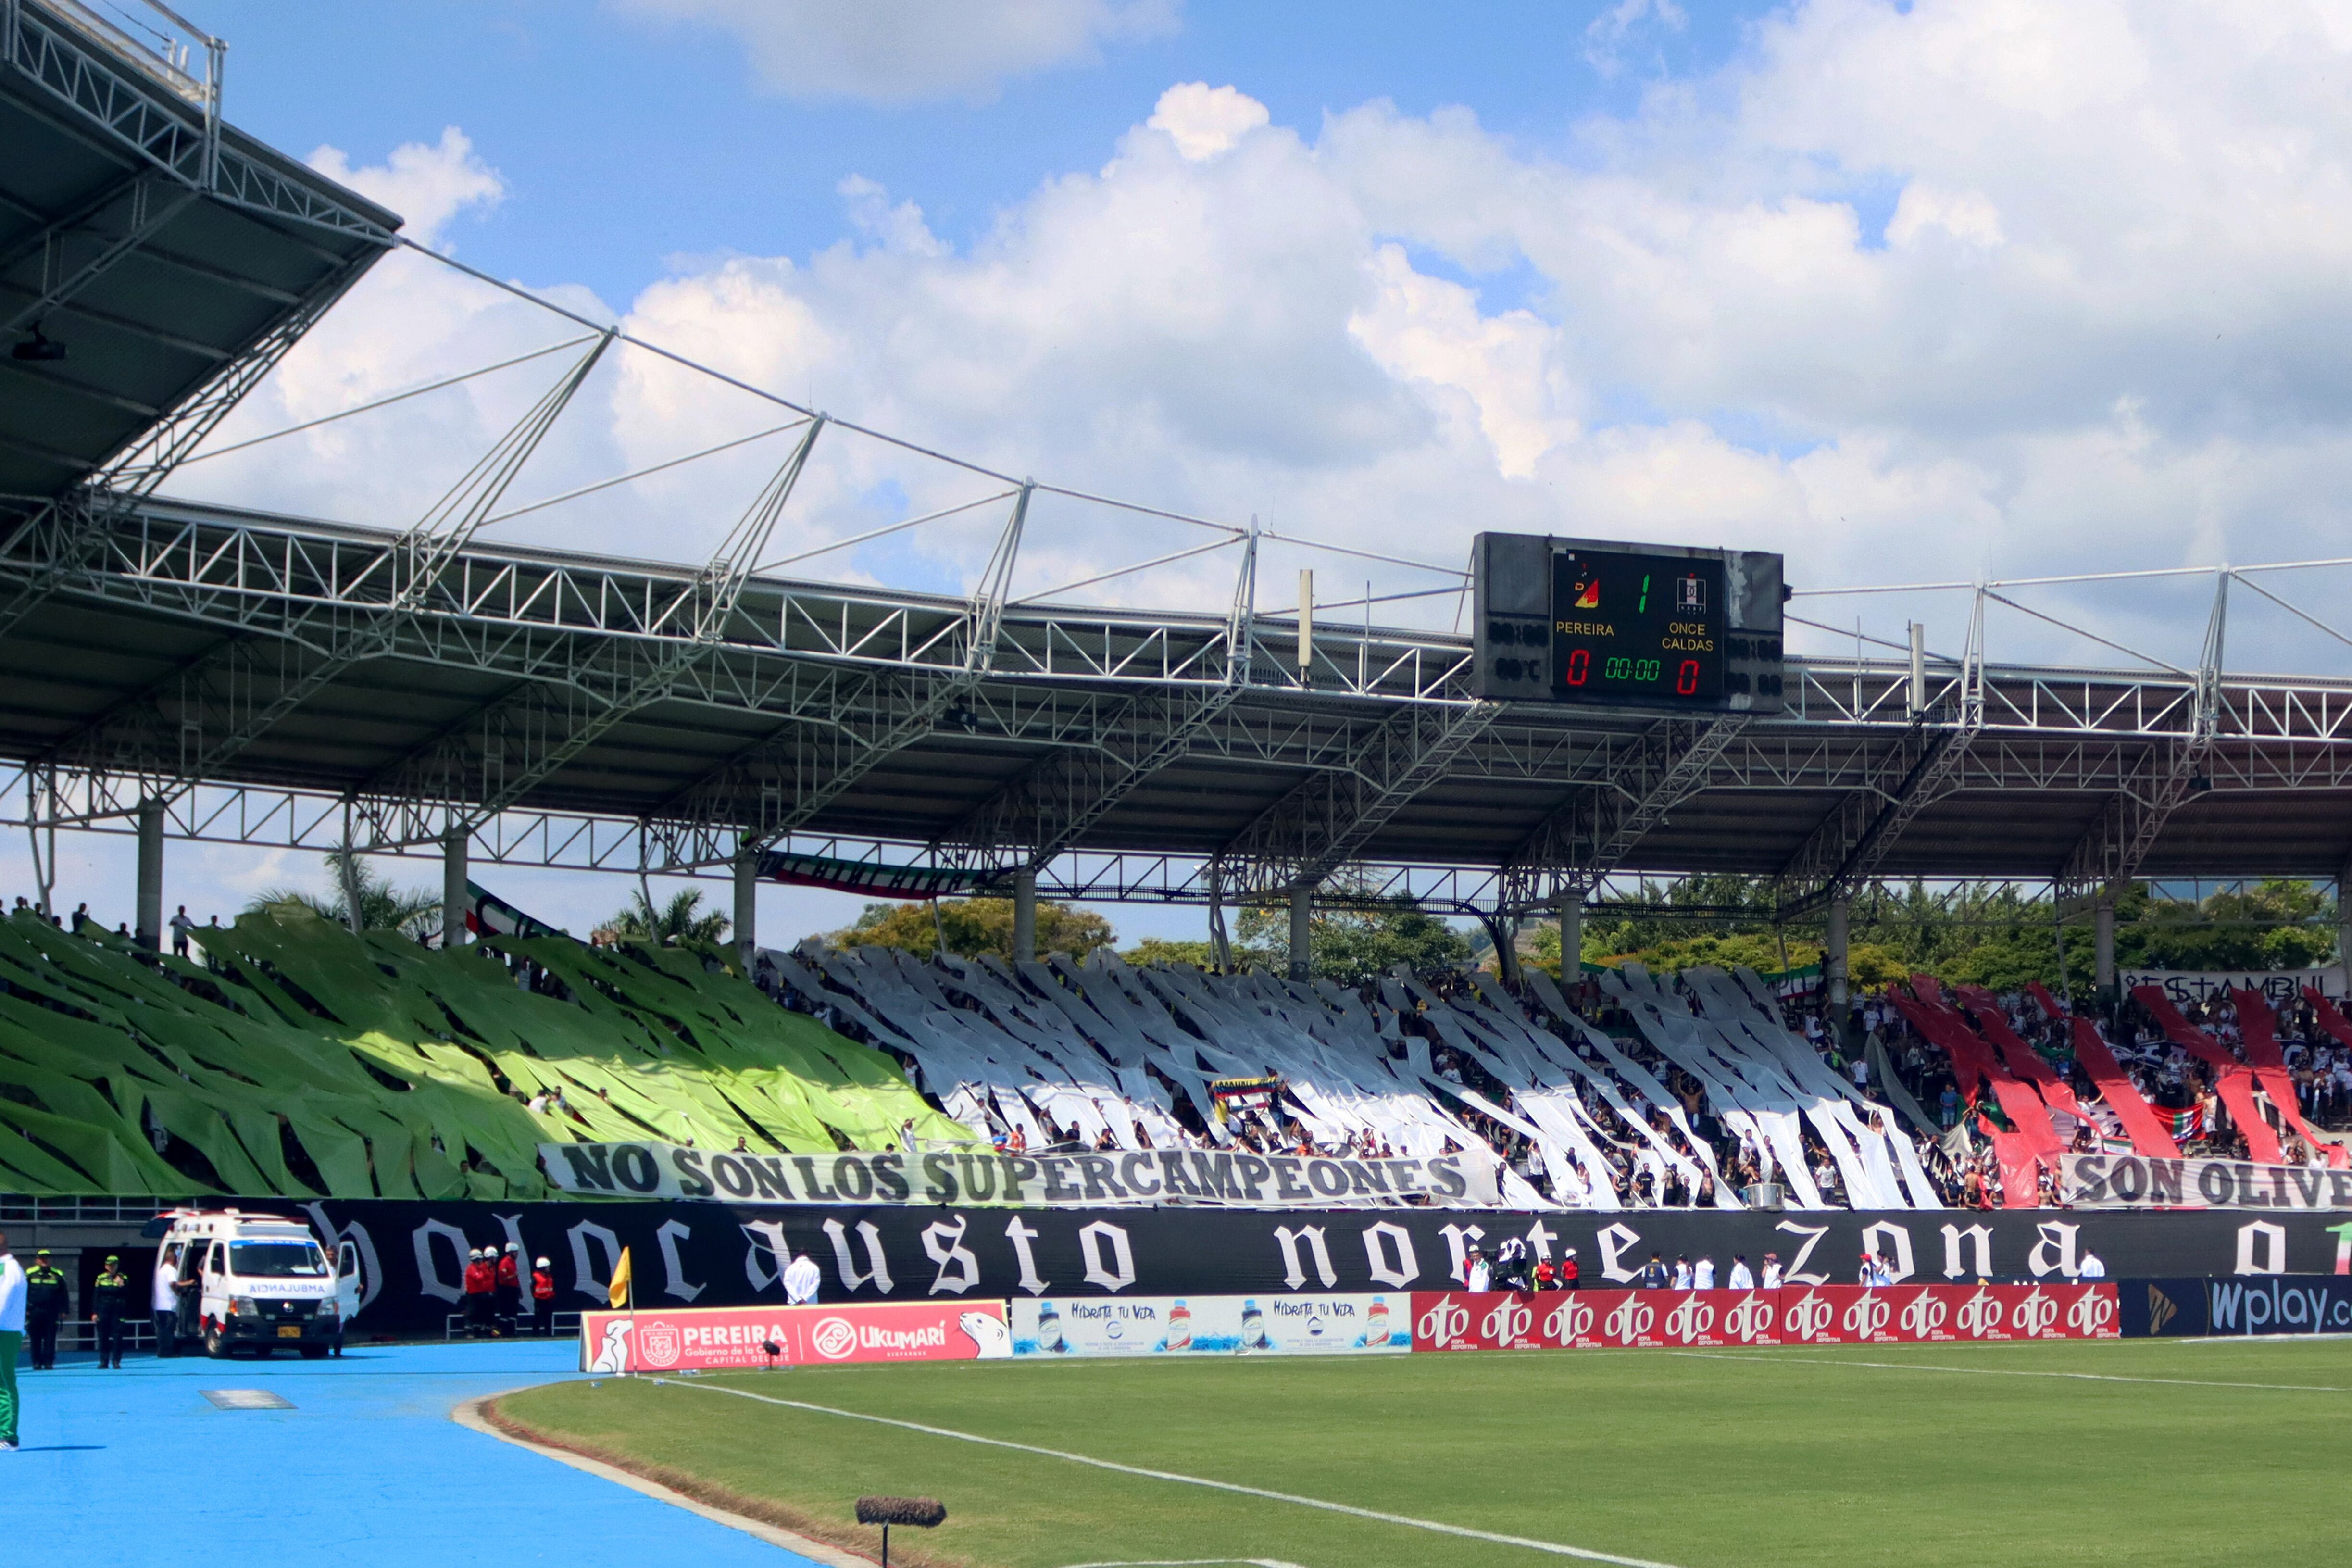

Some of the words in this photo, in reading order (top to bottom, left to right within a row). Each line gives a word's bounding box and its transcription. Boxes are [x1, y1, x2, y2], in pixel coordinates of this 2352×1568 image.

[1639, 574, 1650, 614] 1
[1556, 621, 1614, 636] PEREIRA
[1662, 638, 1713, 652] CALDAS
[1669, 622, 1705, 636] ONCE
[1567, 650, 1589, 685] 0
[1605, 657, 1660, 681] 00:00
[1677, 660, 1699, 694] 0
[562, 1144, 659, 1192] NO
[673, 1149, 796, 1201] SON
[793, 1154, 910, 1201] LOS
[924, 1150, 1466, 1202] SUPERCAMPEONES
[2075, 1155, 2185, 1204] SON
[1775, 1220, 2083, 1287] zona
[1418, 1293, 1469, 1348] oto
[1481, 1293, 1532, 1347] oto
[1543, 1292, 1594, 1346] oto
[1604, 1291, 1654, 1345] oto
[1665, 1291, 1714, 1344] oto
[1725, 1290, 1773, 1342] oto
[1785, 1288, 1833, 1340] oto
[1843, 1288, 1890, 1339] oto
[1901, 1287, 1947, 1339] oto
[1957, 1287, 2002, 1337] oto
[2013, 1286, 2058, 1337] oto
[2068, 1285, 2112, 1335] oto
[2213, 1279, 2352, 1335] Wplay.c
[683, 1324, 788, 1346] PEREIRA
[685, 1347, 728, 1357] Gobierno
[731, 1346, 742, 1355] de
[745, 1345, 753, 1355] la
[705, 1356, 747, 1365] CAPITAL
[751, 1355, 770, 1363] DEL
[860, 1320, 946, 1350] UKUMARÍ
